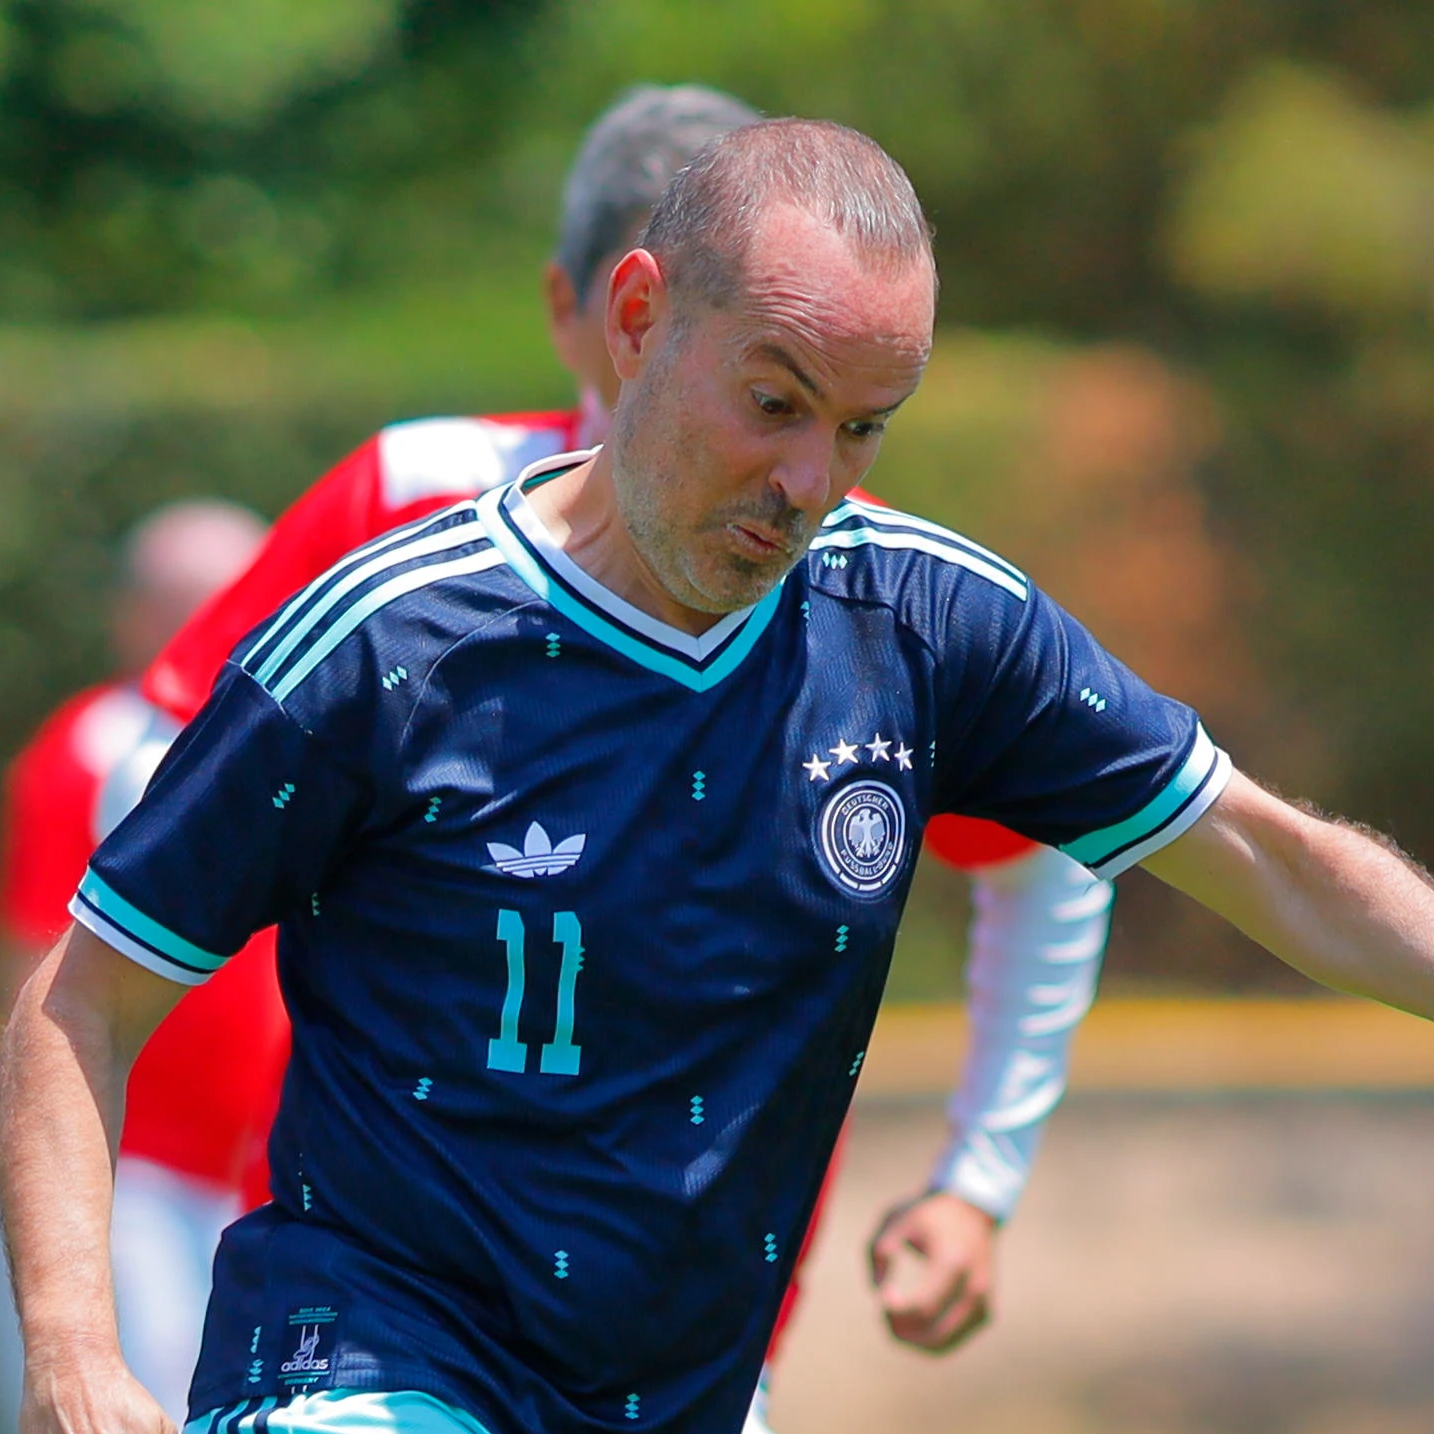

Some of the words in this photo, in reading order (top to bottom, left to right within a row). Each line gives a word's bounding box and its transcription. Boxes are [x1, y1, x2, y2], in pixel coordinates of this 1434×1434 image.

[841, 794, 889, 816] DEUTSCHER
[487, 909, 582, 1075] 11
[280, 1357, 329, 1372] adidas
